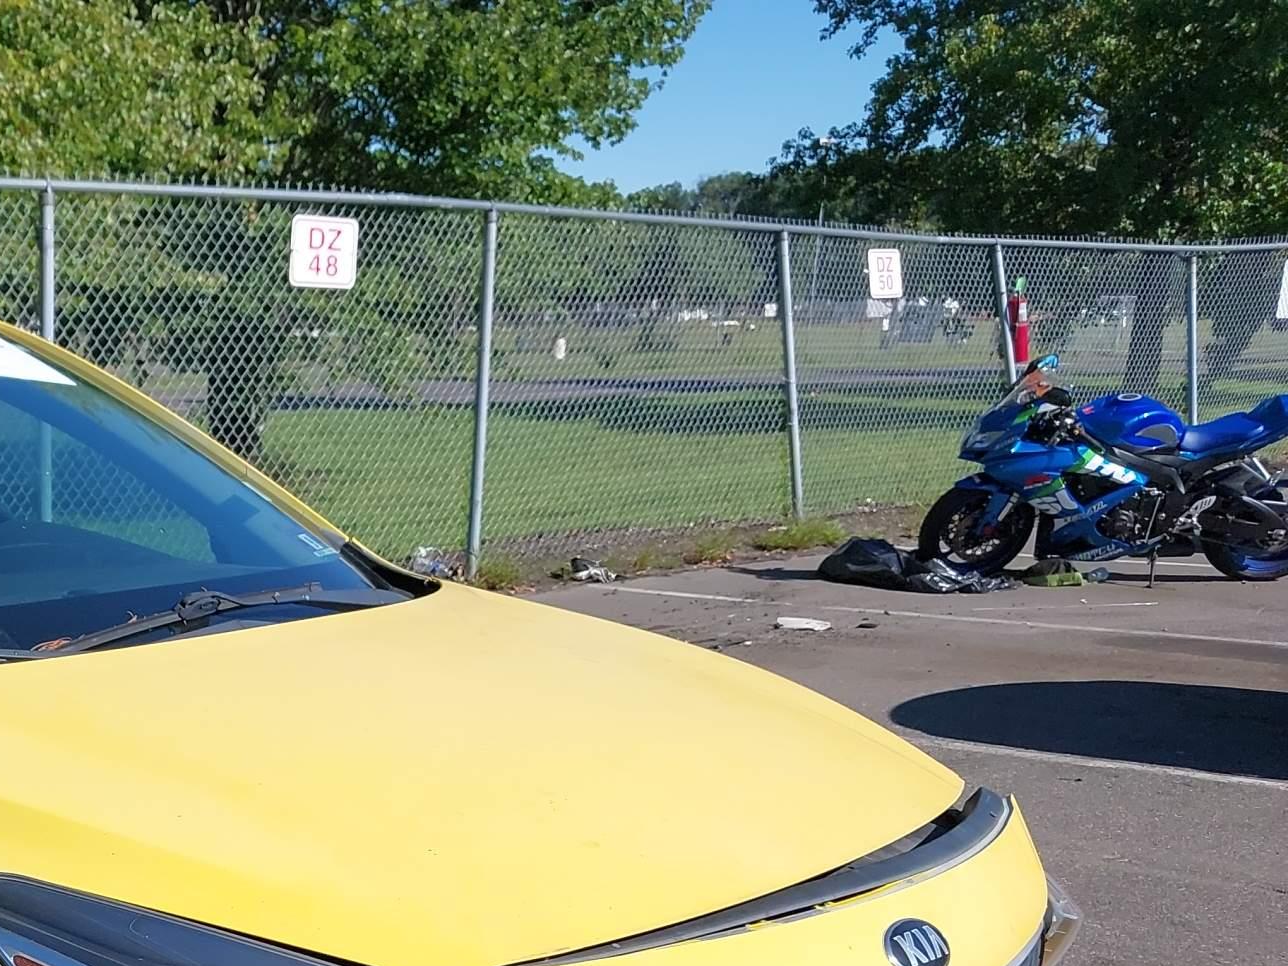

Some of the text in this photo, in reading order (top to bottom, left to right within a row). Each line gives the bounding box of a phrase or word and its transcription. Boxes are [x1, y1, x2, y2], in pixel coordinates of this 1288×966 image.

[309, 227, 342, 251] DZ
[308, 254, 338, 277] 48
[876, 256, 894, 273] DZ
[879, 274, 894, 290] 50
[893, 925, 949, 966] KIA
